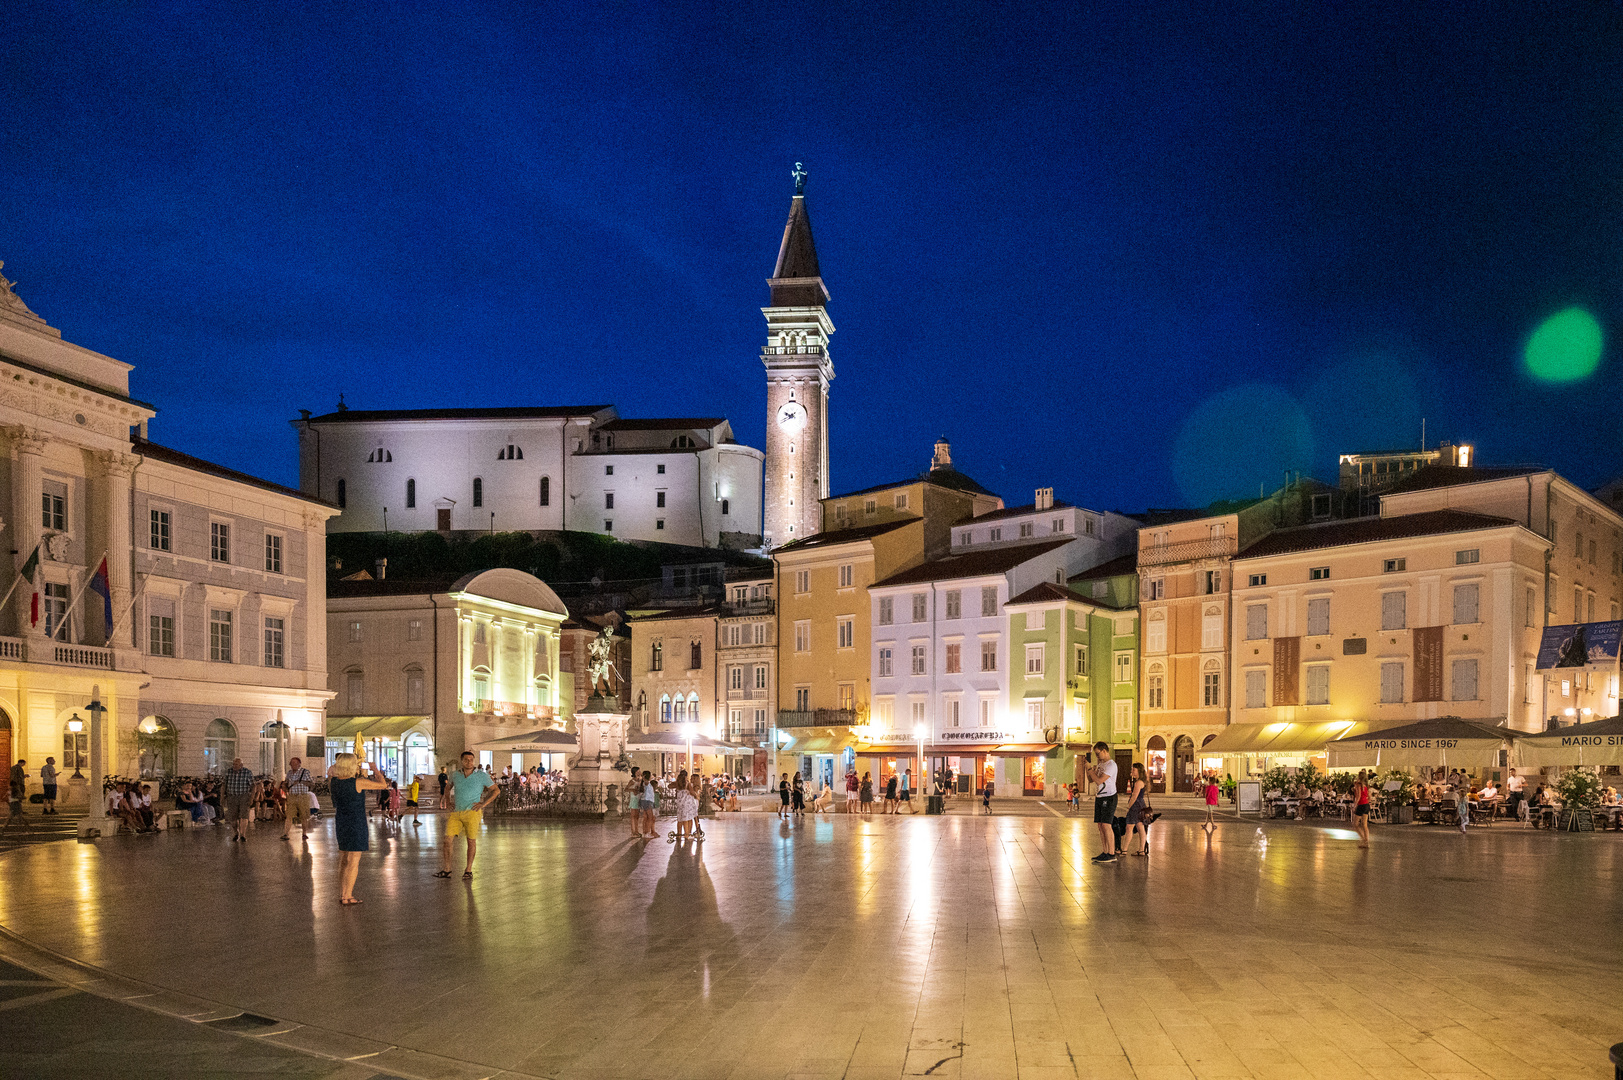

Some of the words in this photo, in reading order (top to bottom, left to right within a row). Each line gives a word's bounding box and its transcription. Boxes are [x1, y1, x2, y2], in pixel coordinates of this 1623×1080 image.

[1365, 741, 1397, 749] MARIO
[1400, 740, 1431, 749] SINCE
[1435, 739, 1458, 748] 1967
[1562, 736, 1602, 746] MARIO
